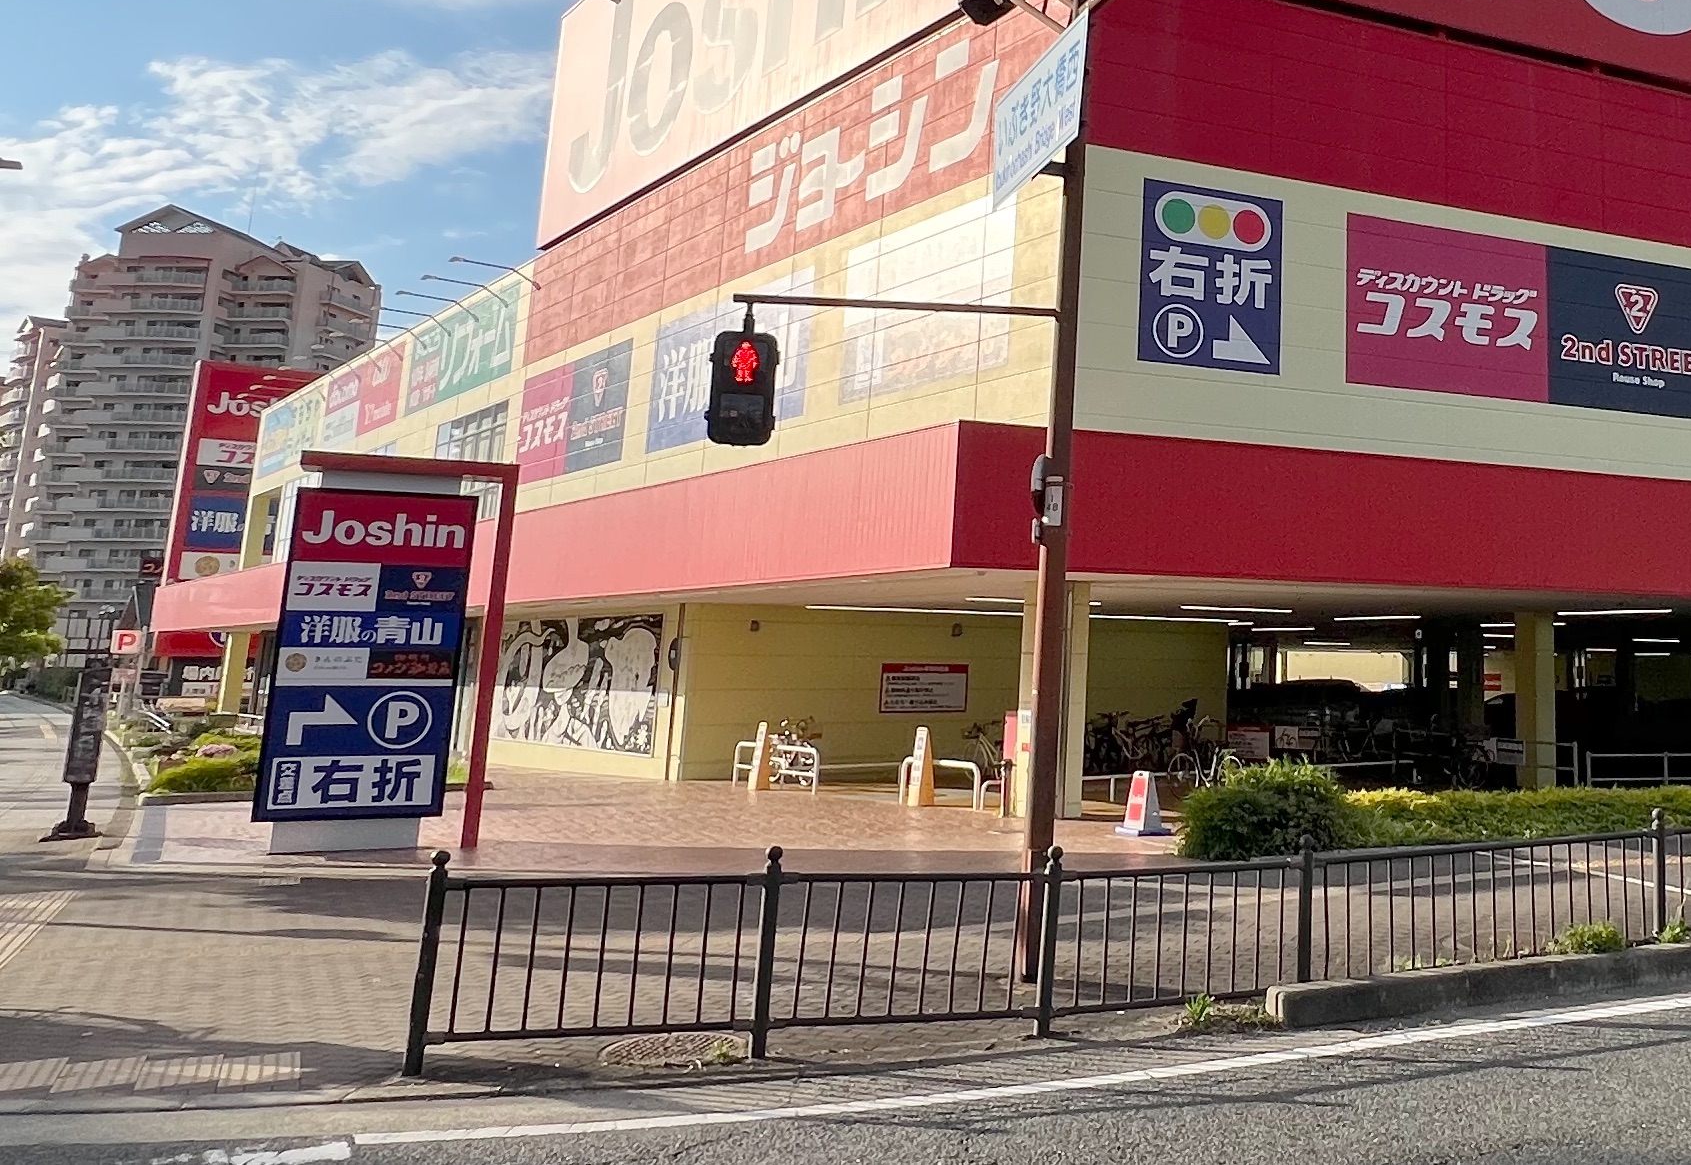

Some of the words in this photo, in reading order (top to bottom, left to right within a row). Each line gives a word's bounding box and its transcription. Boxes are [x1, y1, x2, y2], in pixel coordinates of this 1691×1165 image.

[744, 37, 999, 254] ジョーシン
[1148, 245, 1272, 310] 右折
[1355, 267, 1469, 300] ディスカウント
[1355, 291, 1540, 352] コスモス
[1559, 334, 1614, 366] 2nd
[302, 510, 466, 549] Joshin
[294, 582, 372, 597] コスモス
[301, 615, 443, 645] 洋服の青山
[312, 759, 422, 804] 右折
